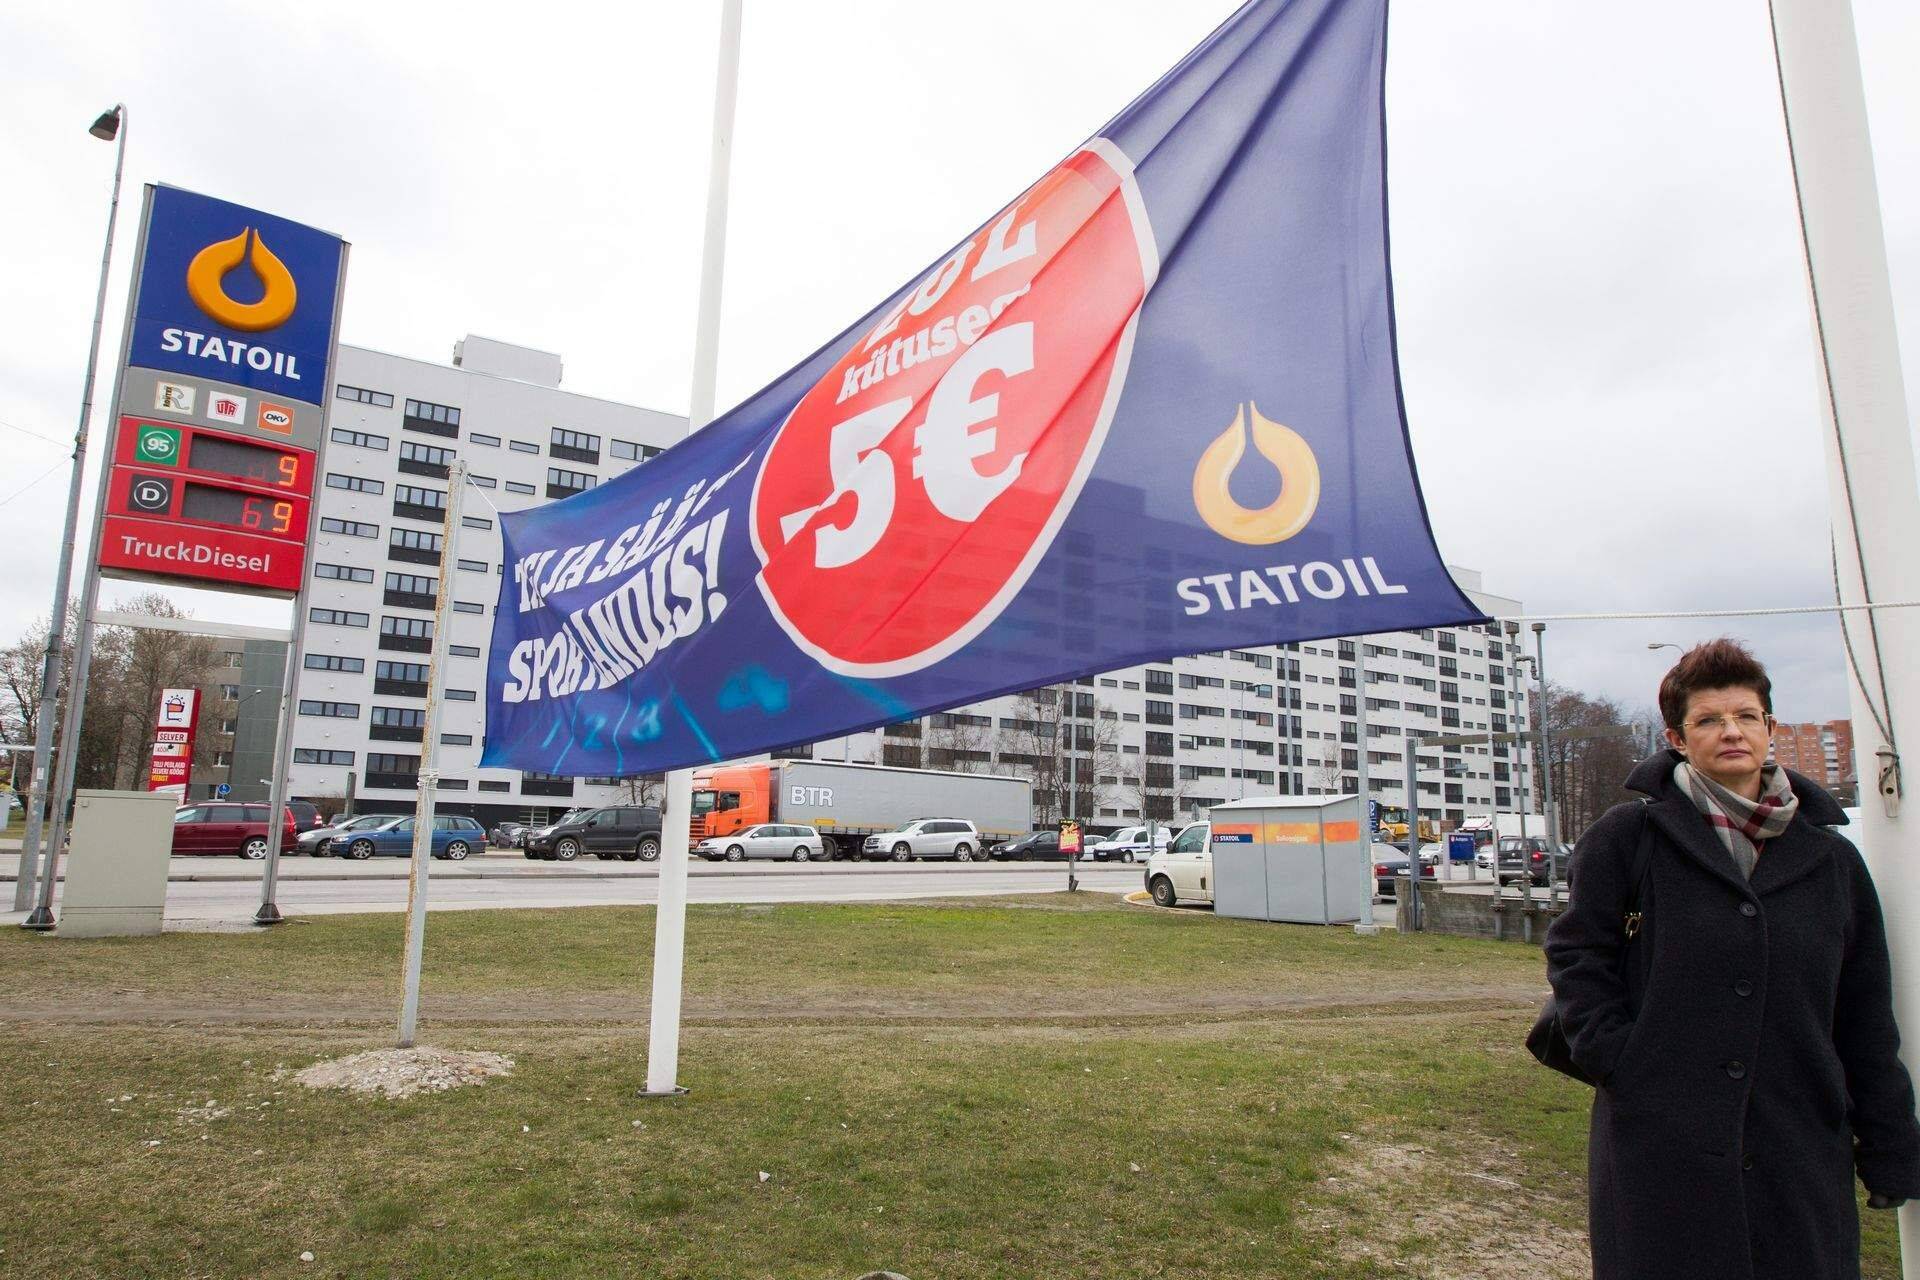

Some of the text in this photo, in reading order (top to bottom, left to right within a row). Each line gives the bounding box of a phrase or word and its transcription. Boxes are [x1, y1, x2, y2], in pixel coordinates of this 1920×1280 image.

[161, 328, 301, 381] STATOIL
[217, 400, 239, 416] UTA
[265, 413, 288, 423] DKV
[147, 438, 170, 452] 95
[141, 487, 160, 501] D
[121, 535, 271, 573] TruckDiesel
[1176, 557, 1409, 616] STATOIL
[159, 732, 185, 741] SELVER
[791, 785, 834, 807] BTR
